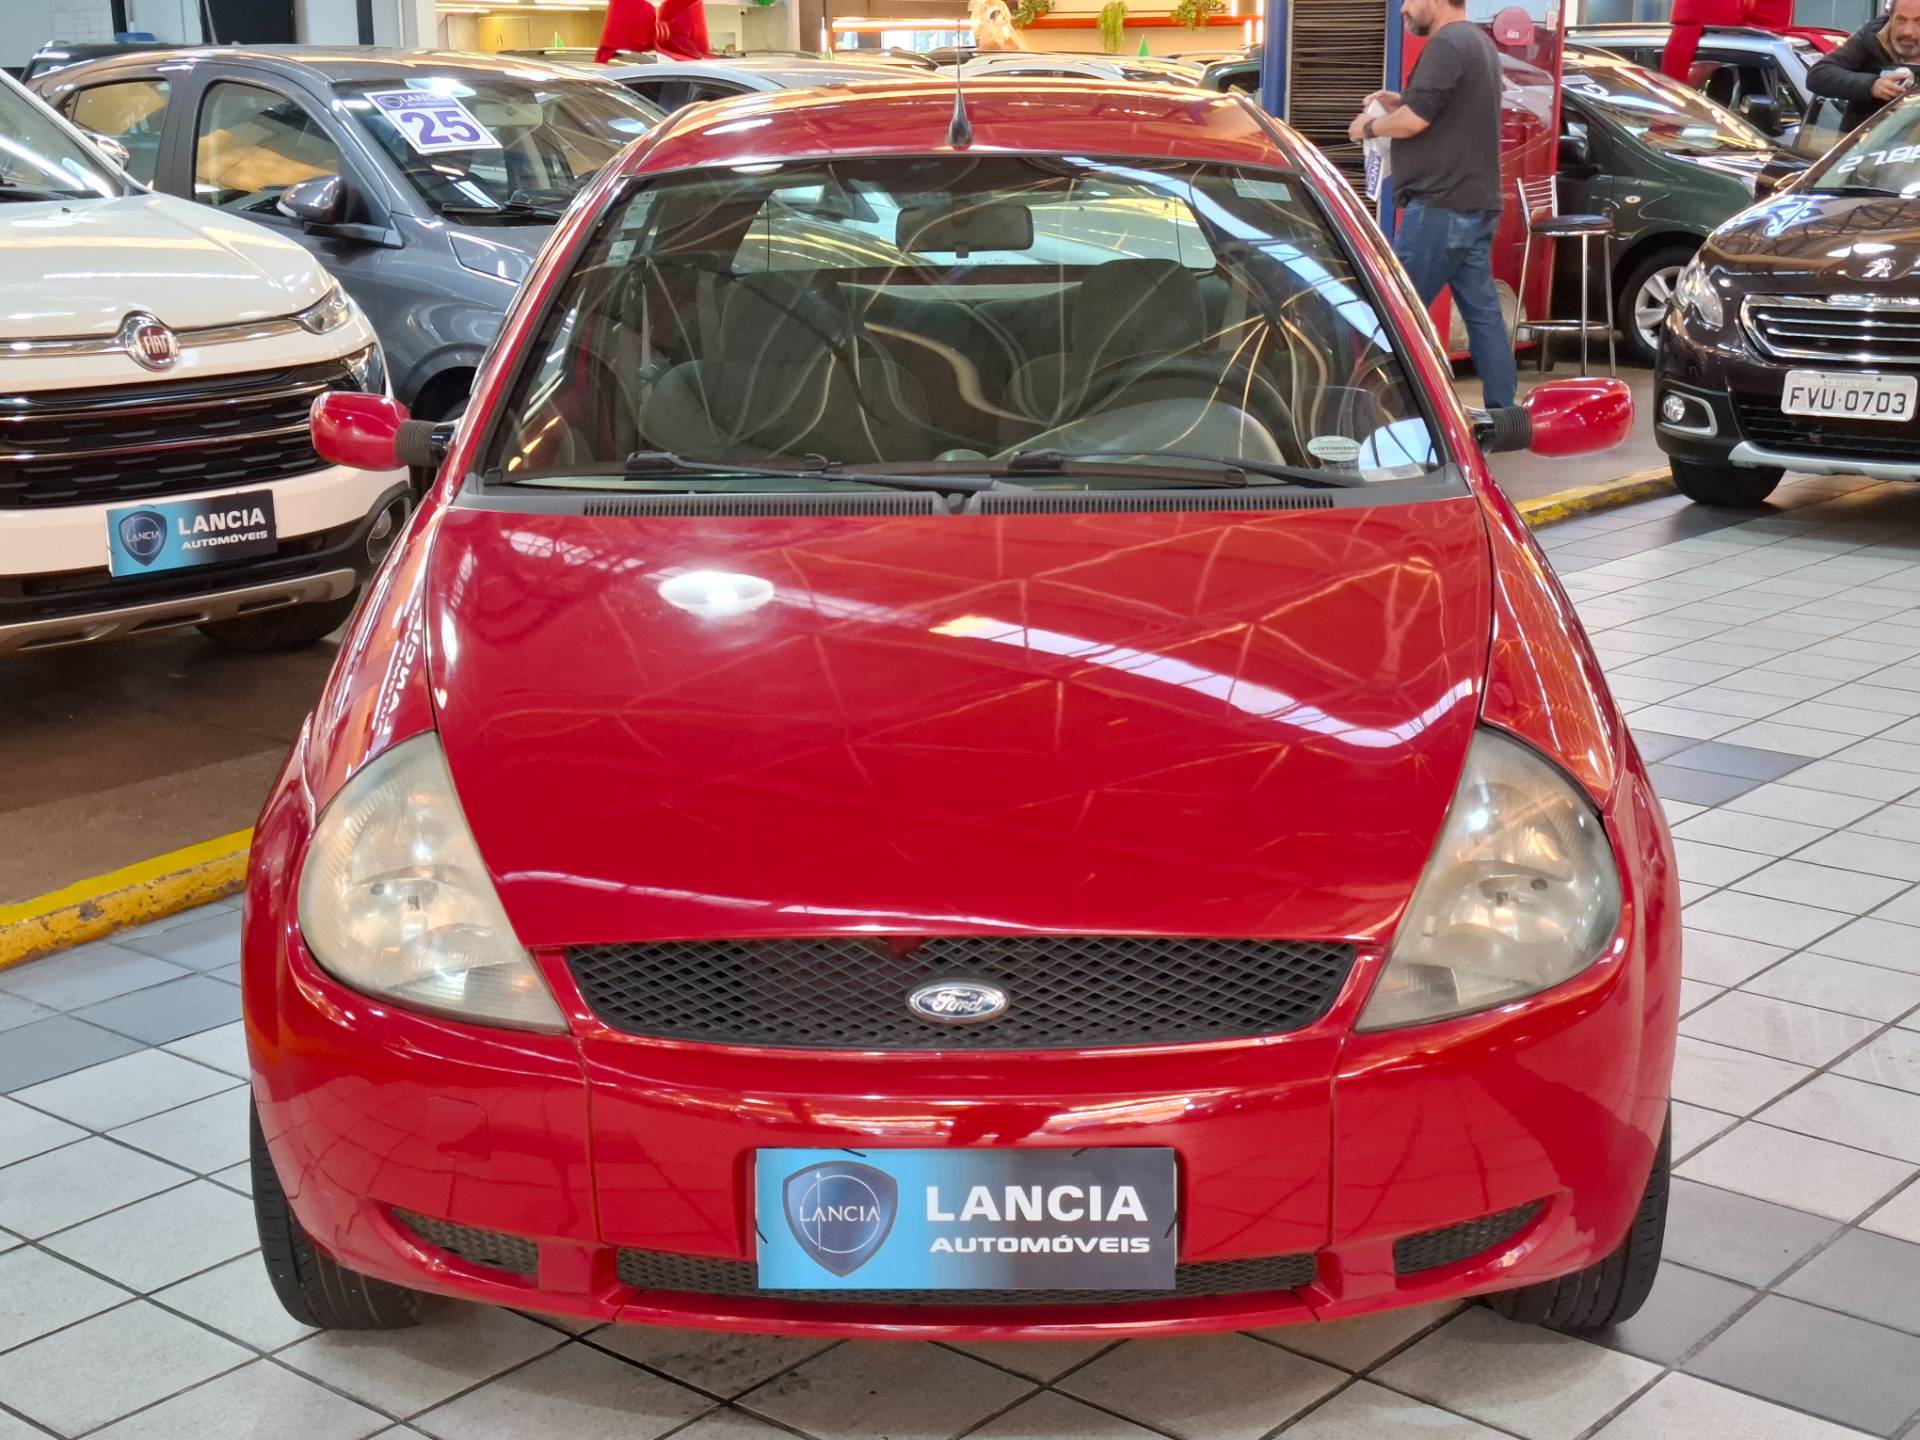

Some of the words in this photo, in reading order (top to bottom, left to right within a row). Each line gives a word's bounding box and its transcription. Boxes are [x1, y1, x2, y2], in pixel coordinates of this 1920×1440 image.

[400, 110, 481, 145] 25
[142, 333, 169, 356] FIAT
[177, 507, 266, 536] LANCIA
[126, 529, 162, 543] LANCIA
[181, 530, 269, 550] AUTOMÓVEIS
[931, 990, 985, 1012] Ford
[798, 1204, 881, 1223] LANCIA
[926, 1184, 1149, 1223] LANCIA
[928, 1233, 1151, 1254] AUTOMÓVEIS
